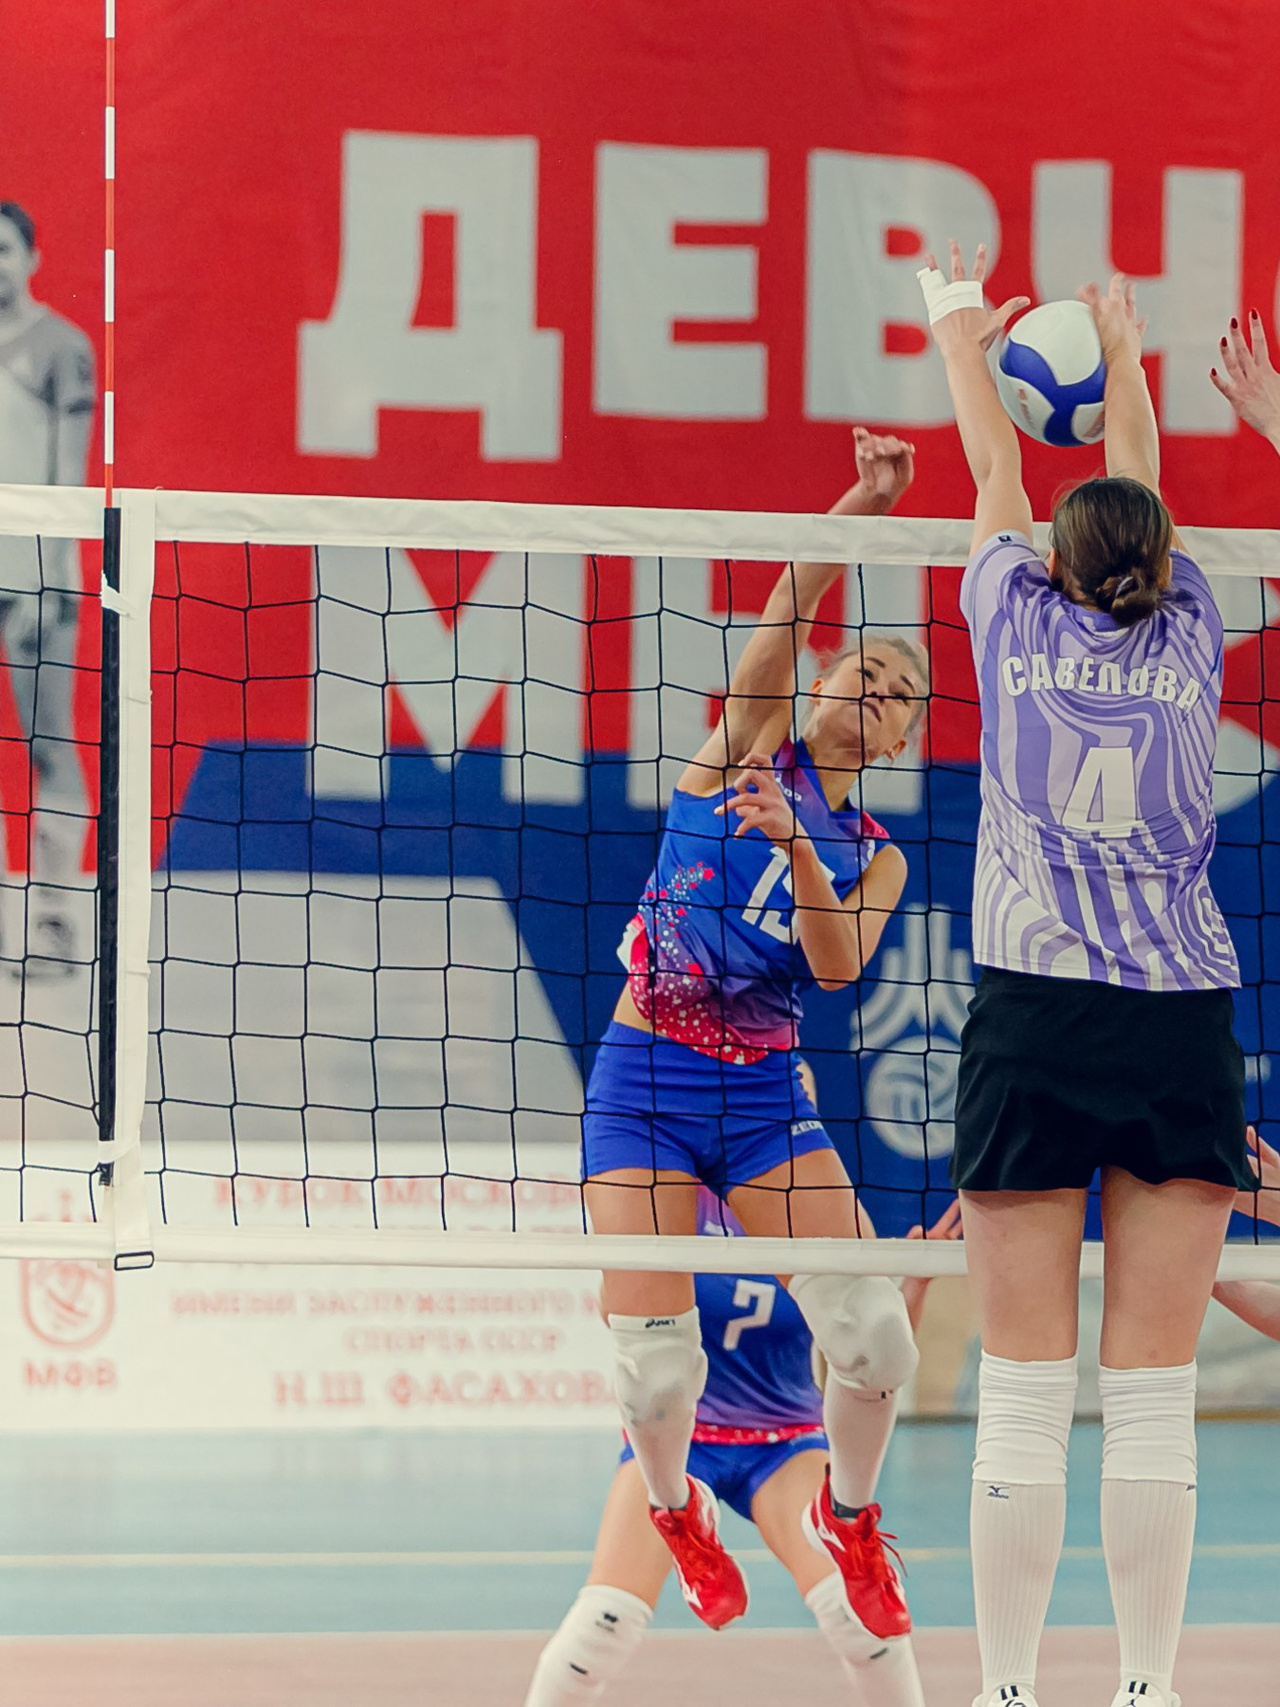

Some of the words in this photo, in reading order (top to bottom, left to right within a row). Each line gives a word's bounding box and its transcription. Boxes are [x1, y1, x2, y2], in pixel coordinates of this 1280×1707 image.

[1001, 652, 1201, 714] САВЕЛОВА
[1061, 746, 1143, 838] 4
[383, 1174, 585, 1213] МОСКОВ
[723, 1279, 776, 1350] 7
